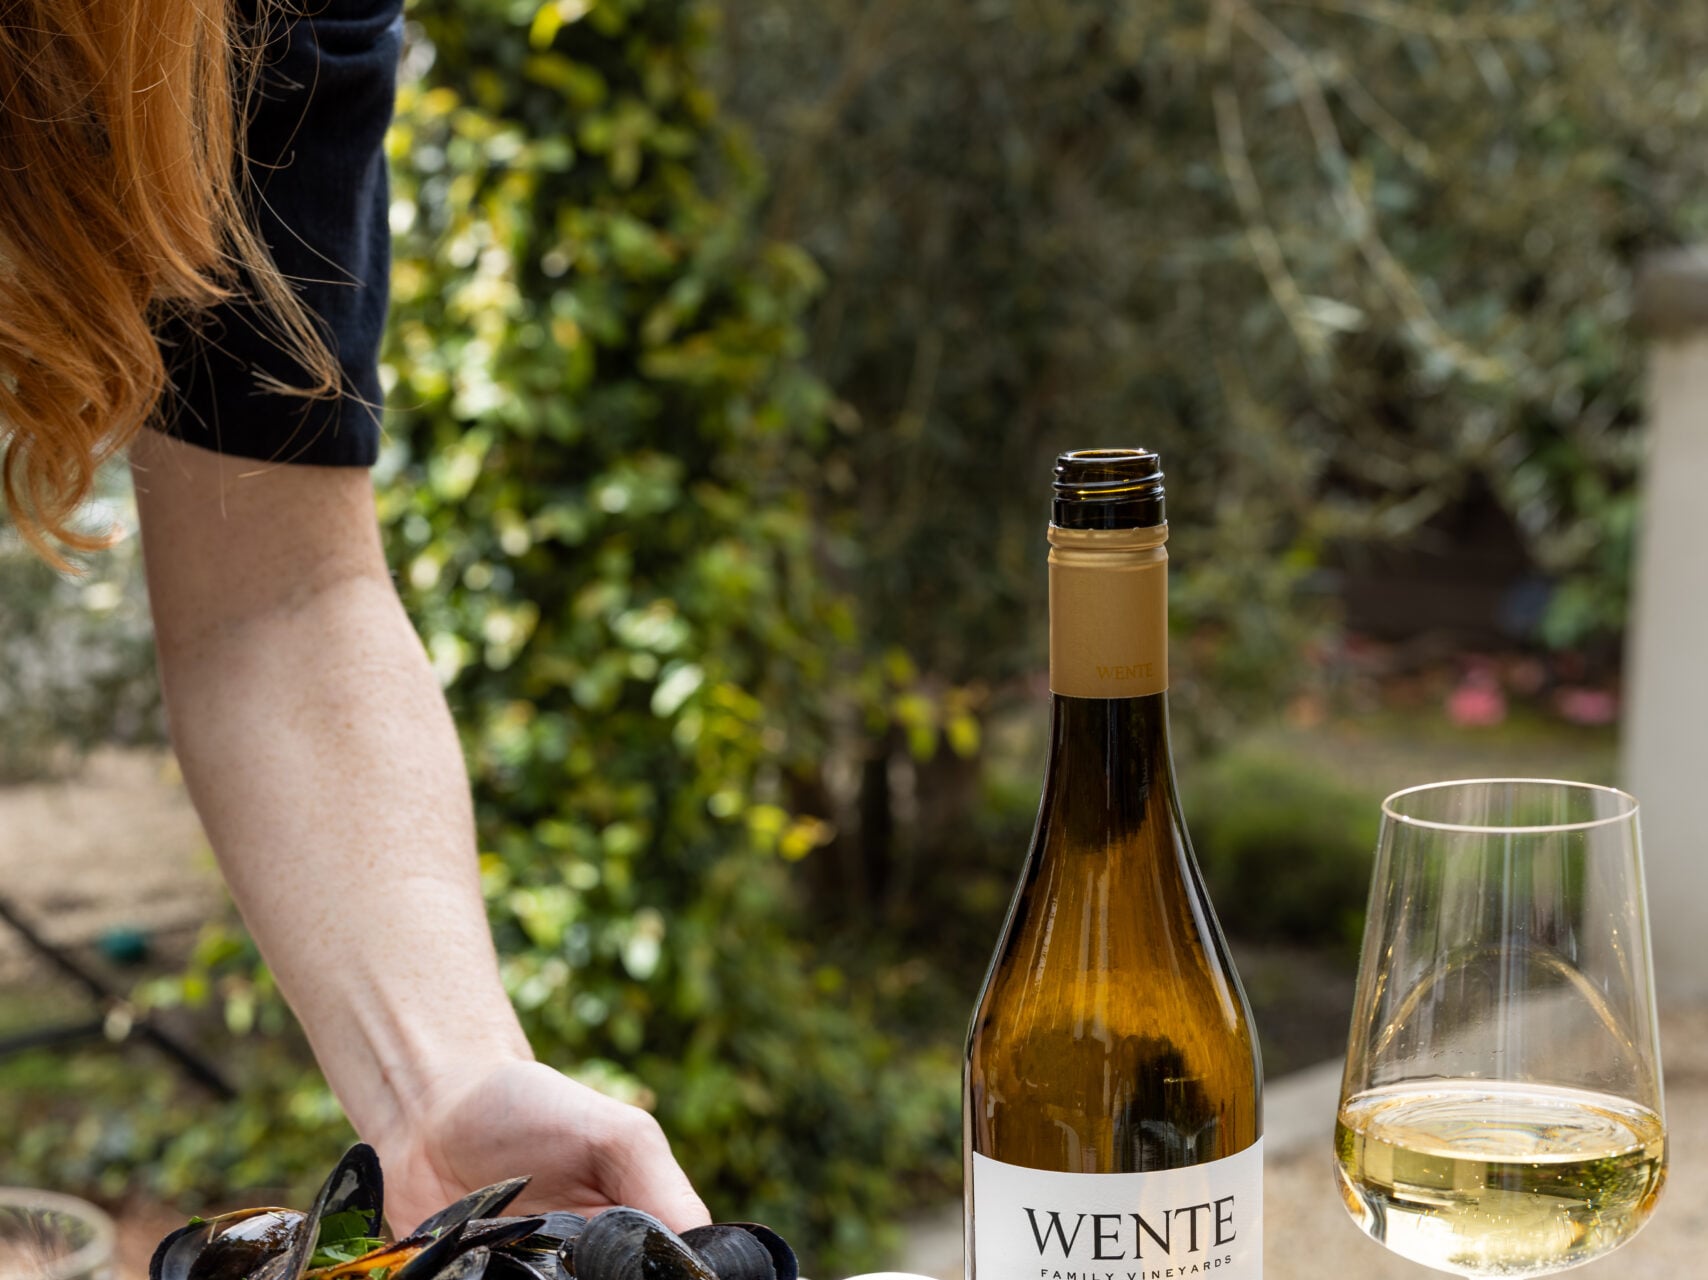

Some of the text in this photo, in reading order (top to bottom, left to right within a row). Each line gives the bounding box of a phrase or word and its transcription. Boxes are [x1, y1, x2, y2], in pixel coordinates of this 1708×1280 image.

[1095, 662, 1153, 680] WENTE
[1022, 1195, 1237, 1260] WENTE
[1127, 1255, 1232, 1280] VINEYARDS
